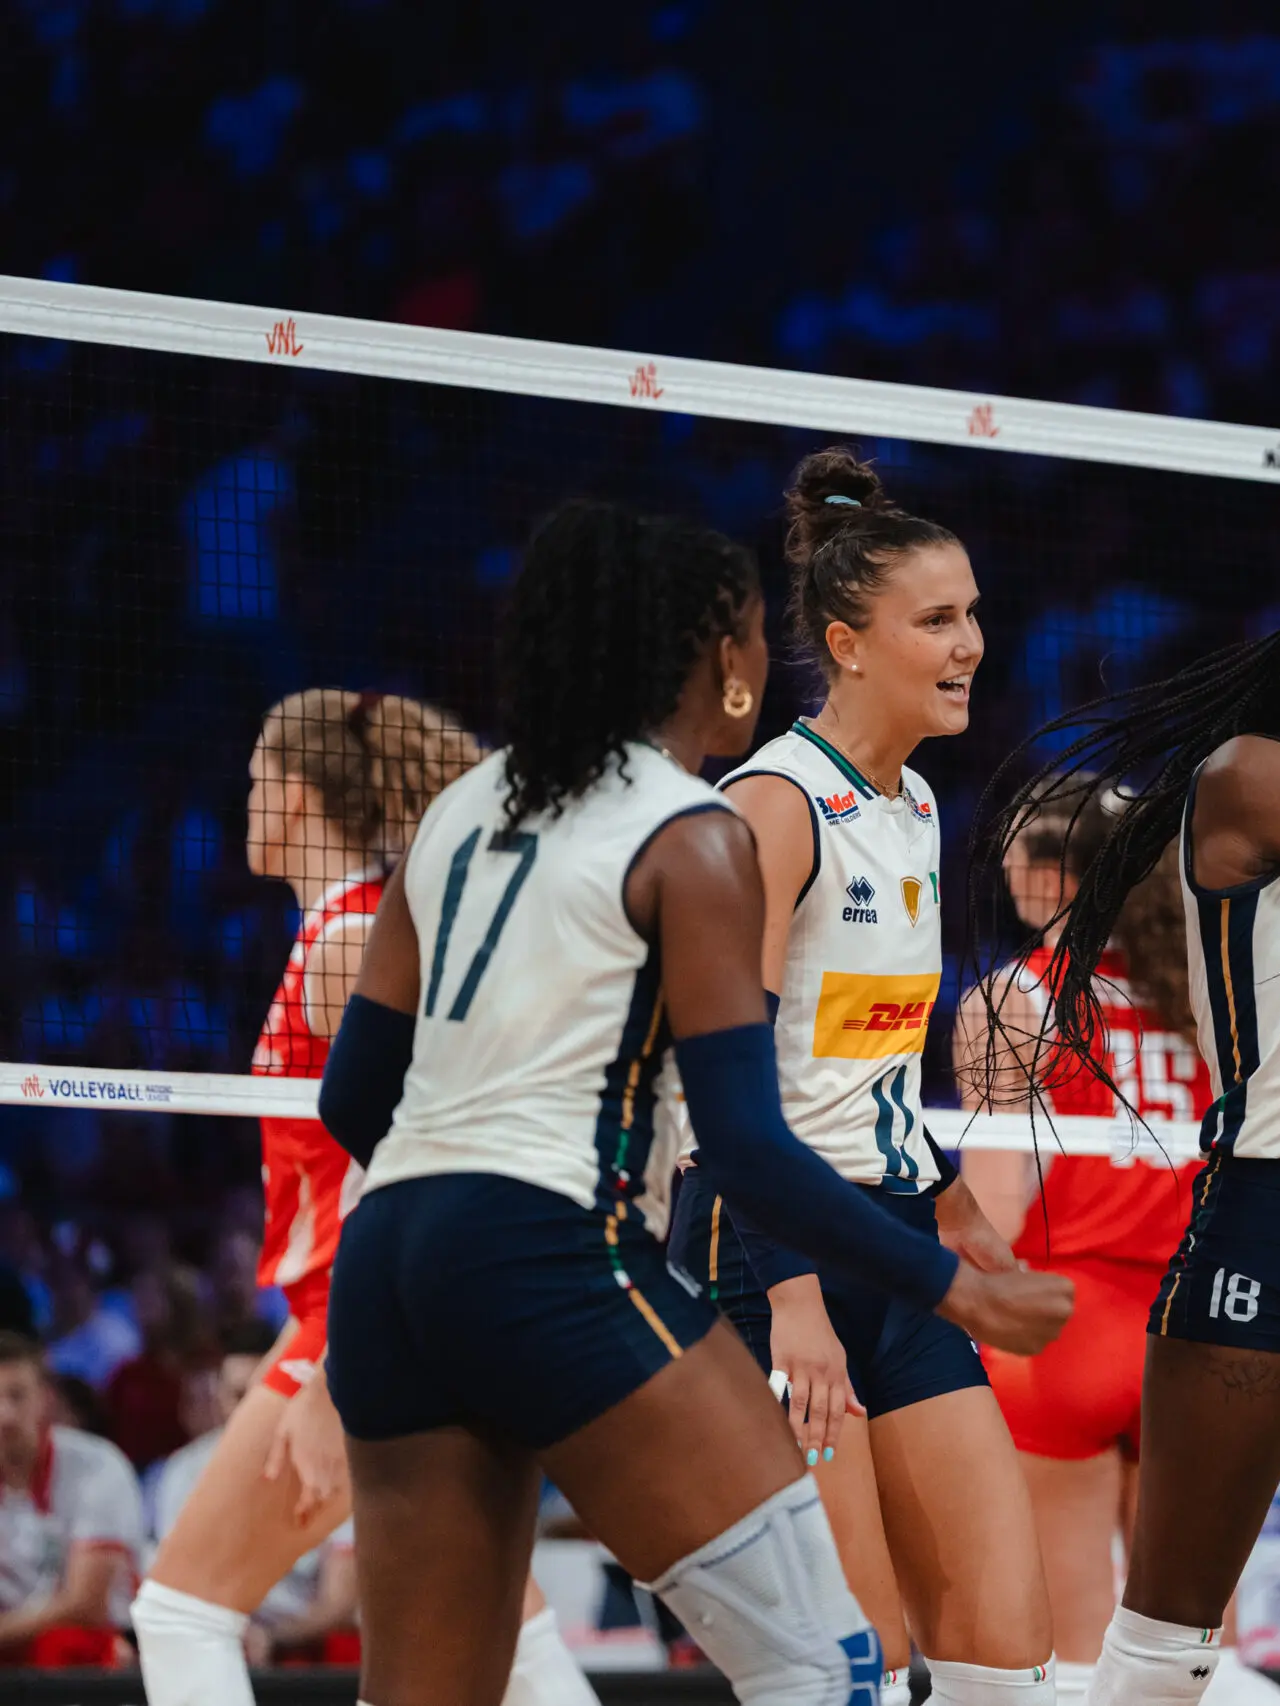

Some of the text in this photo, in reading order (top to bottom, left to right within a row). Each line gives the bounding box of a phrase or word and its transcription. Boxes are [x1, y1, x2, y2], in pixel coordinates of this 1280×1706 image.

[265, 316, 304, 357] VNL
[425, 824, 540, 1022] 17
[842, 907, 878, 924] errea
[49, 1079, 144, 1102] VOLLEYBALL
[1209, 1267, 1262, 1323] 18
